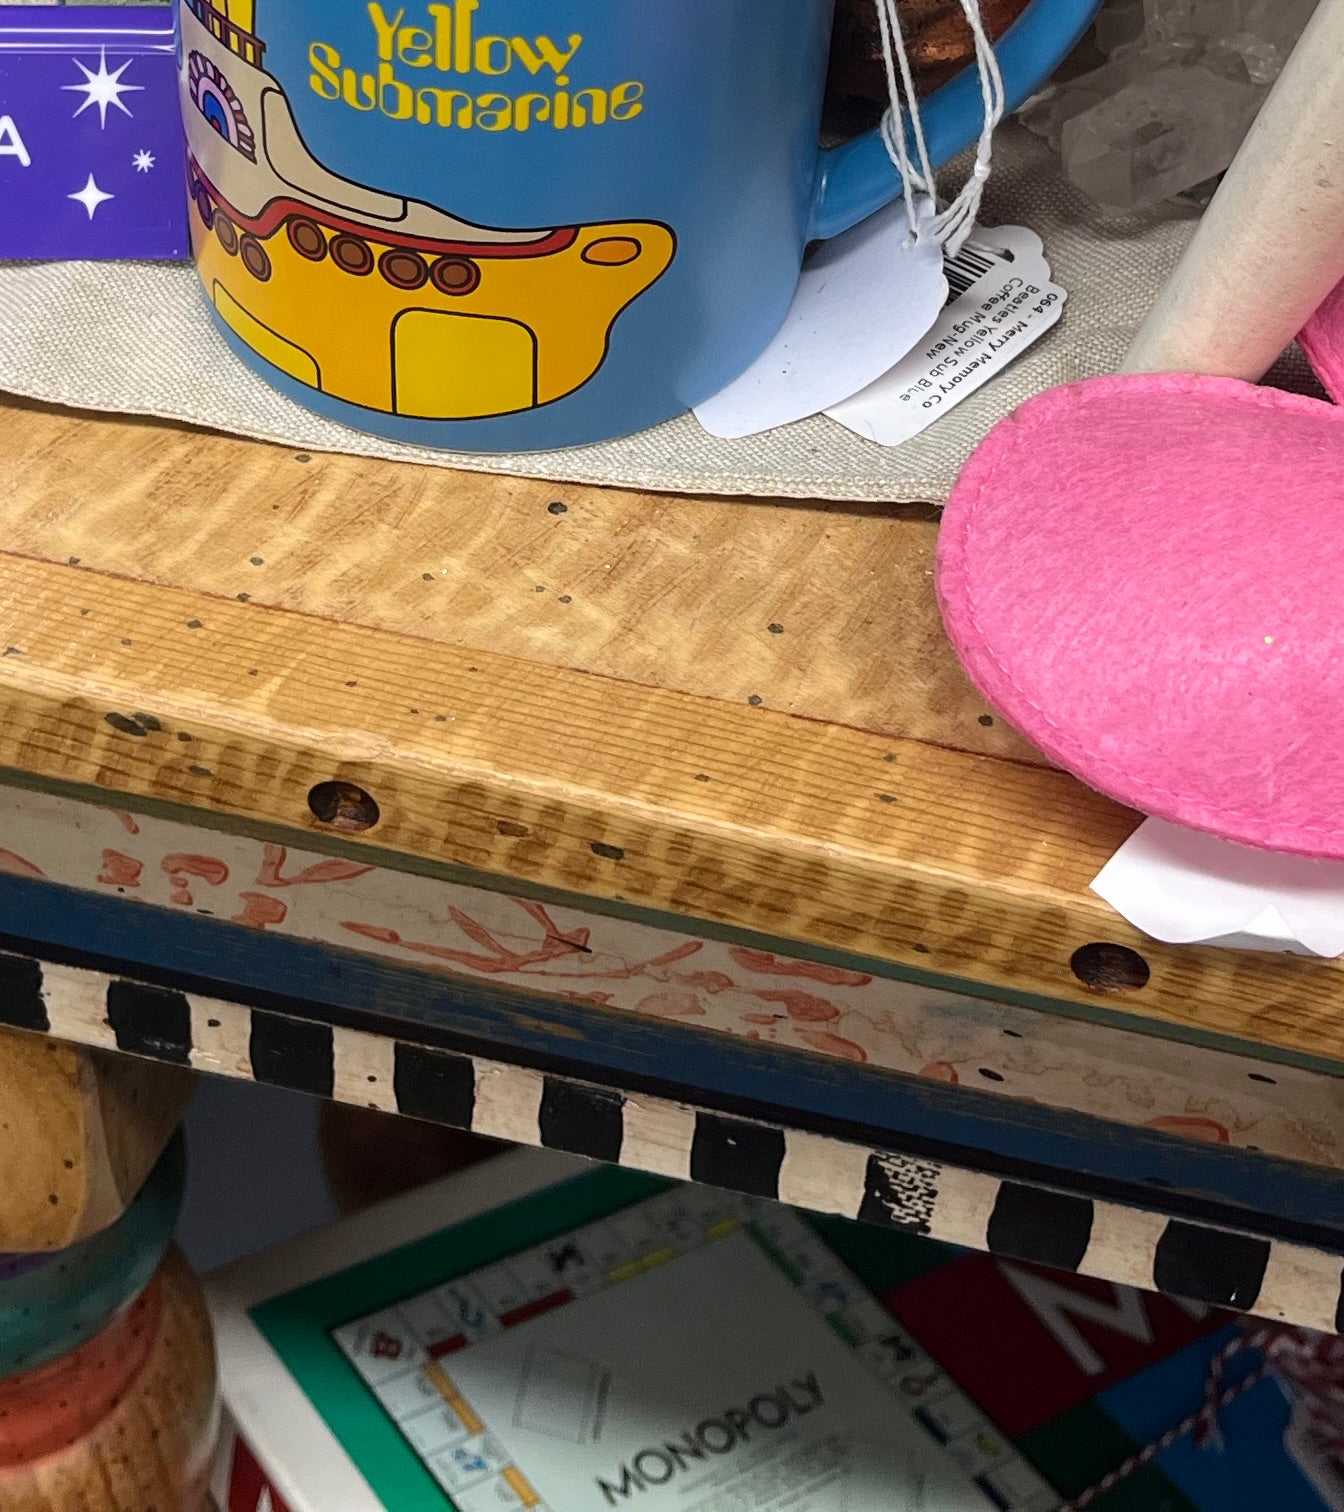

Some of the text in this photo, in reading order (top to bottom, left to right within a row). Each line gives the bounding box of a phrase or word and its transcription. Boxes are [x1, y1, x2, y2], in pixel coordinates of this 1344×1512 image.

[308, 39, 646, 133] Submarine
[925, 277, 1021, 359] Coffee Mug-New
[992, 284, 1037, 323] Beatles
[1033, 293, 1056, 313] 064
[955, 323, 993, 357] Yellow
[990, 319, 1025, 351] Merry
[930, 356, 955, 379] Sub
[940, 350, 989, 393] Memory
[923, 394, 940, 410] Co
[594, 1368, 827, 1508] MONOPOLY
